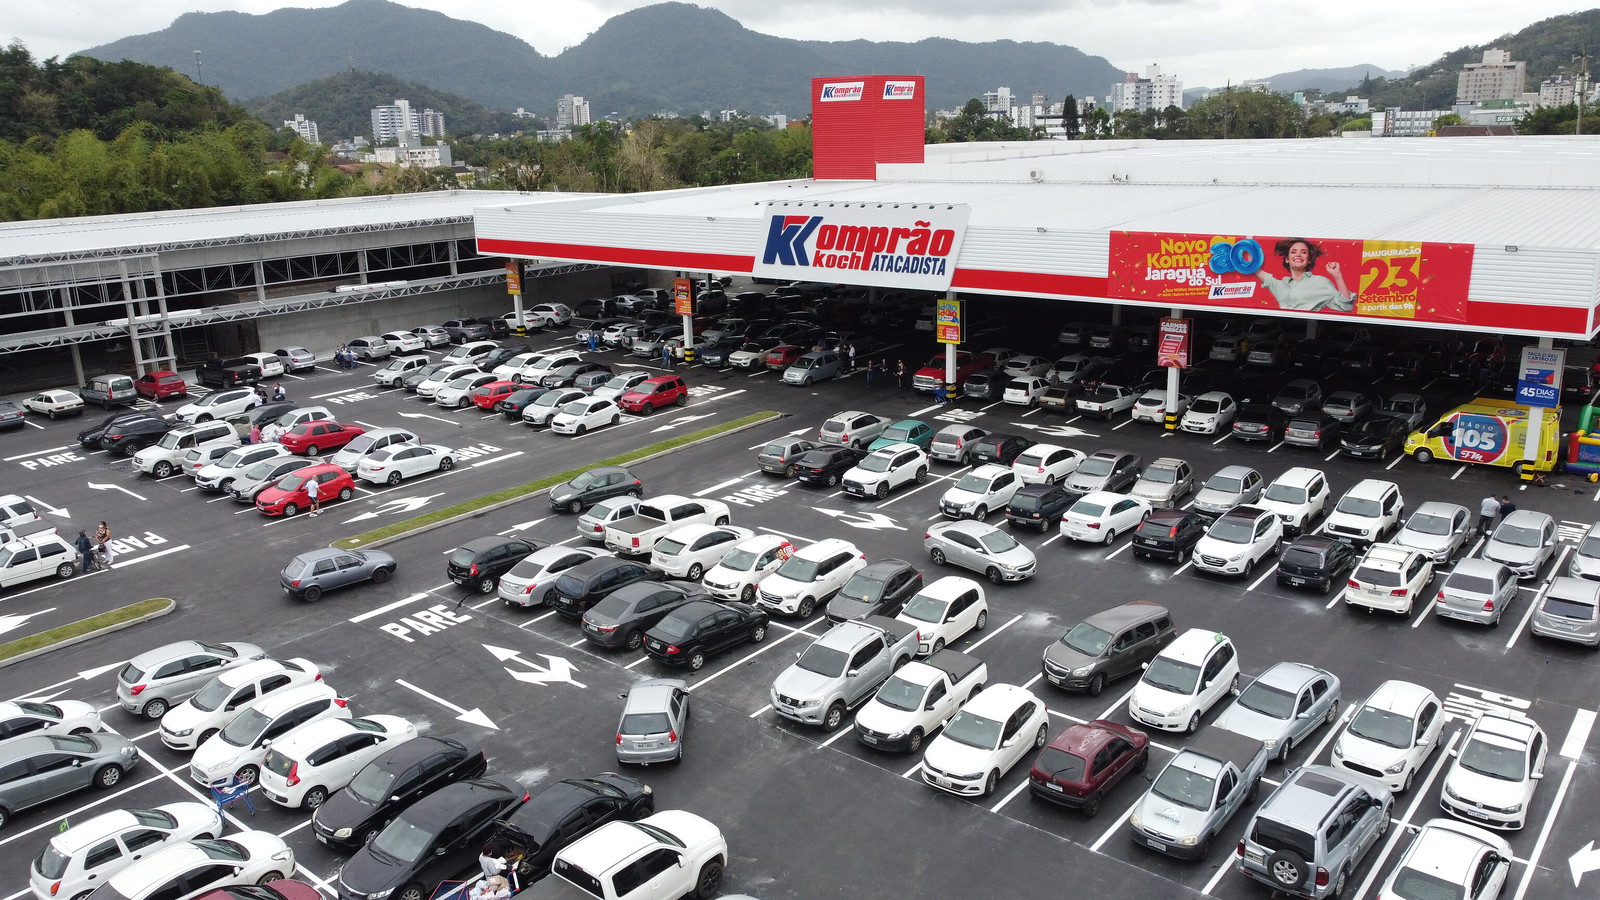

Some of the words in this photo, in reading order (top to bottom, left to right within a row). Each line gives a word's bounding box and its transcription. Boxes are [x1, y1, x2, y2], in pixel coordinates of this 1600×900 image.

[1160, 238, 1207, 254] Novo
[1362, 246, 1422, 258] INAUGURAÇÃO
[812, 251, 861, 271] koch
[871, 254, 946, 275] ATACADISTA
[1145, 264, 1206, 283] Jaraguá
[1188, 275, 1203, 286] do
[1205, 275, 1222, 286] Sul
[1360, 257, 1419, 295] 23
[1359, 291, 1416, 304] Setembro
[1368, 304, 1387, 312] partir
[1388, 302, 1402, 310] das
[1403, 302, 1414, 310] 9h
[1520, 387, 1535, 397] 45
[1535, 388, 1554, 397] DIAS
[1460, 420, 1494, 431] RÁDIO
[1452, 427, 1496, 450] 105
[19, 452, 86, 470] PARE
[721, 484, 789, 507] PARE
[379, 604, 473, 643] PARE
